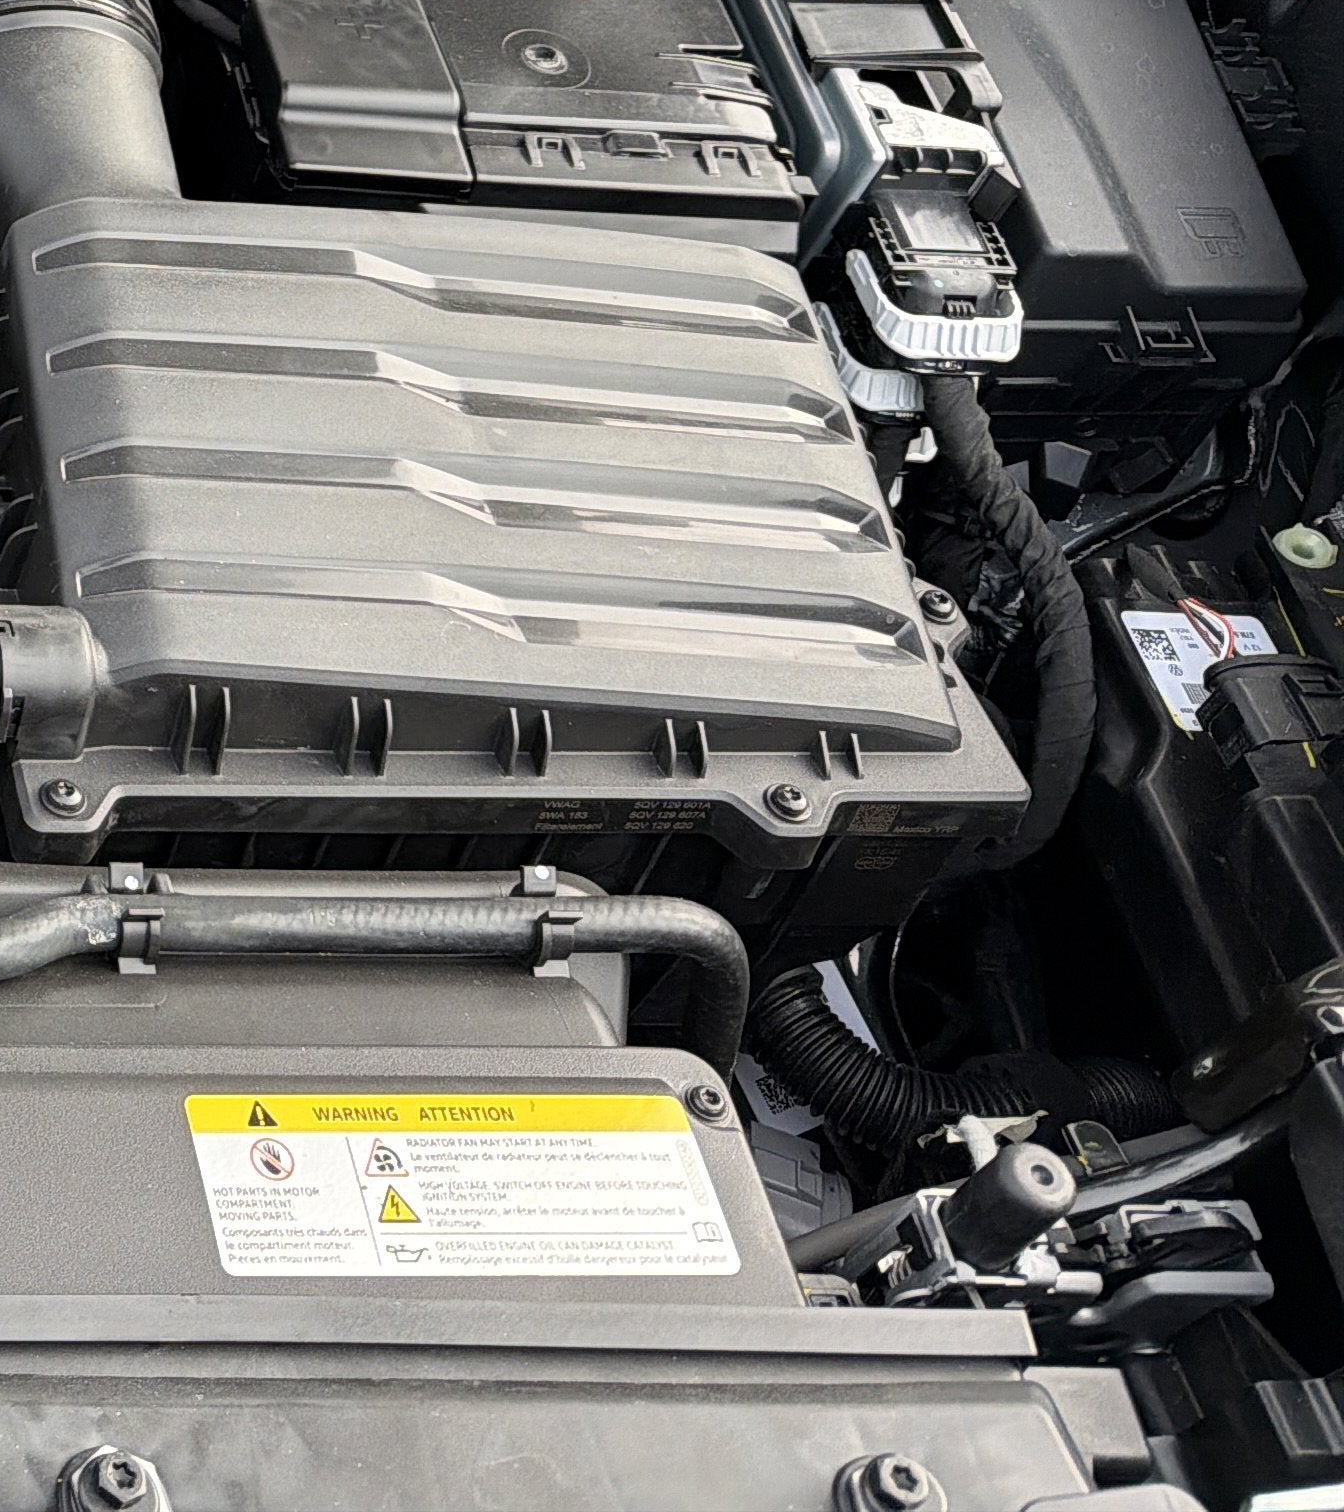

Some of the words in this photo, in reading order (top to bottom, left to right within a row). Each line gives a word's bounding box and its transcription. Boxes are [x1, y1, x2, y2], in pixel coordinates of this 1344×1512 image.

[312, 1106, 400, 1122] WARNING
[419, 1106, 515, 1123] ATTENTION
[406, 1138, 456, 1147] RADIATOR
[480, 1138, 500, 1147] MAY
[502, 1138, 533, 1147] START
[213, 1187, 233, 1197] HOT
[283, 1187, 320, 1197] MOTOR
[218, 1211, 260, 1221] MOVING
